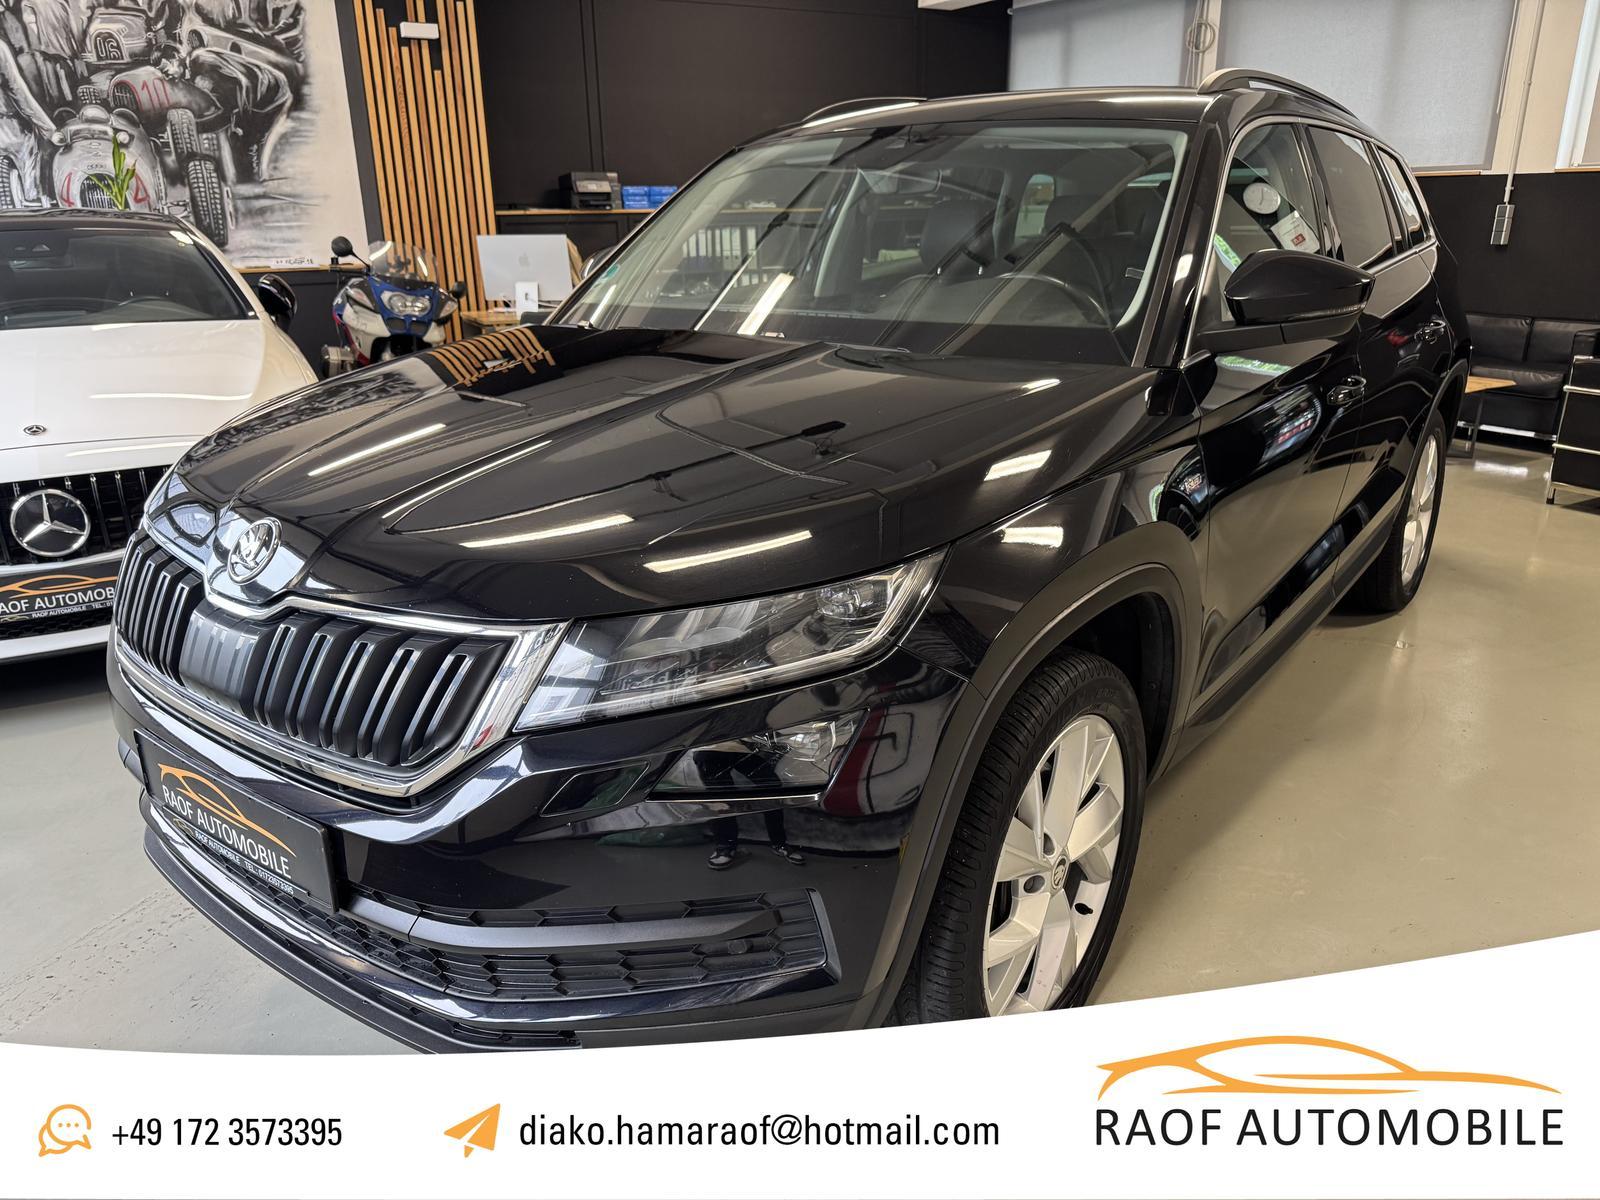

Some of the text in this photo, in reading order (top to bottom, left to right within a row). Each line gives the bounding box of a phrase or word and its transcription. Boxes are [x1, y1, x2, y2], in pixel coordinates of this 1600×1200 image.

[162, 785, 292, 879] RAOF AUTOMOBILE
[208, 840, 241, 865] AUTOMOBILE
